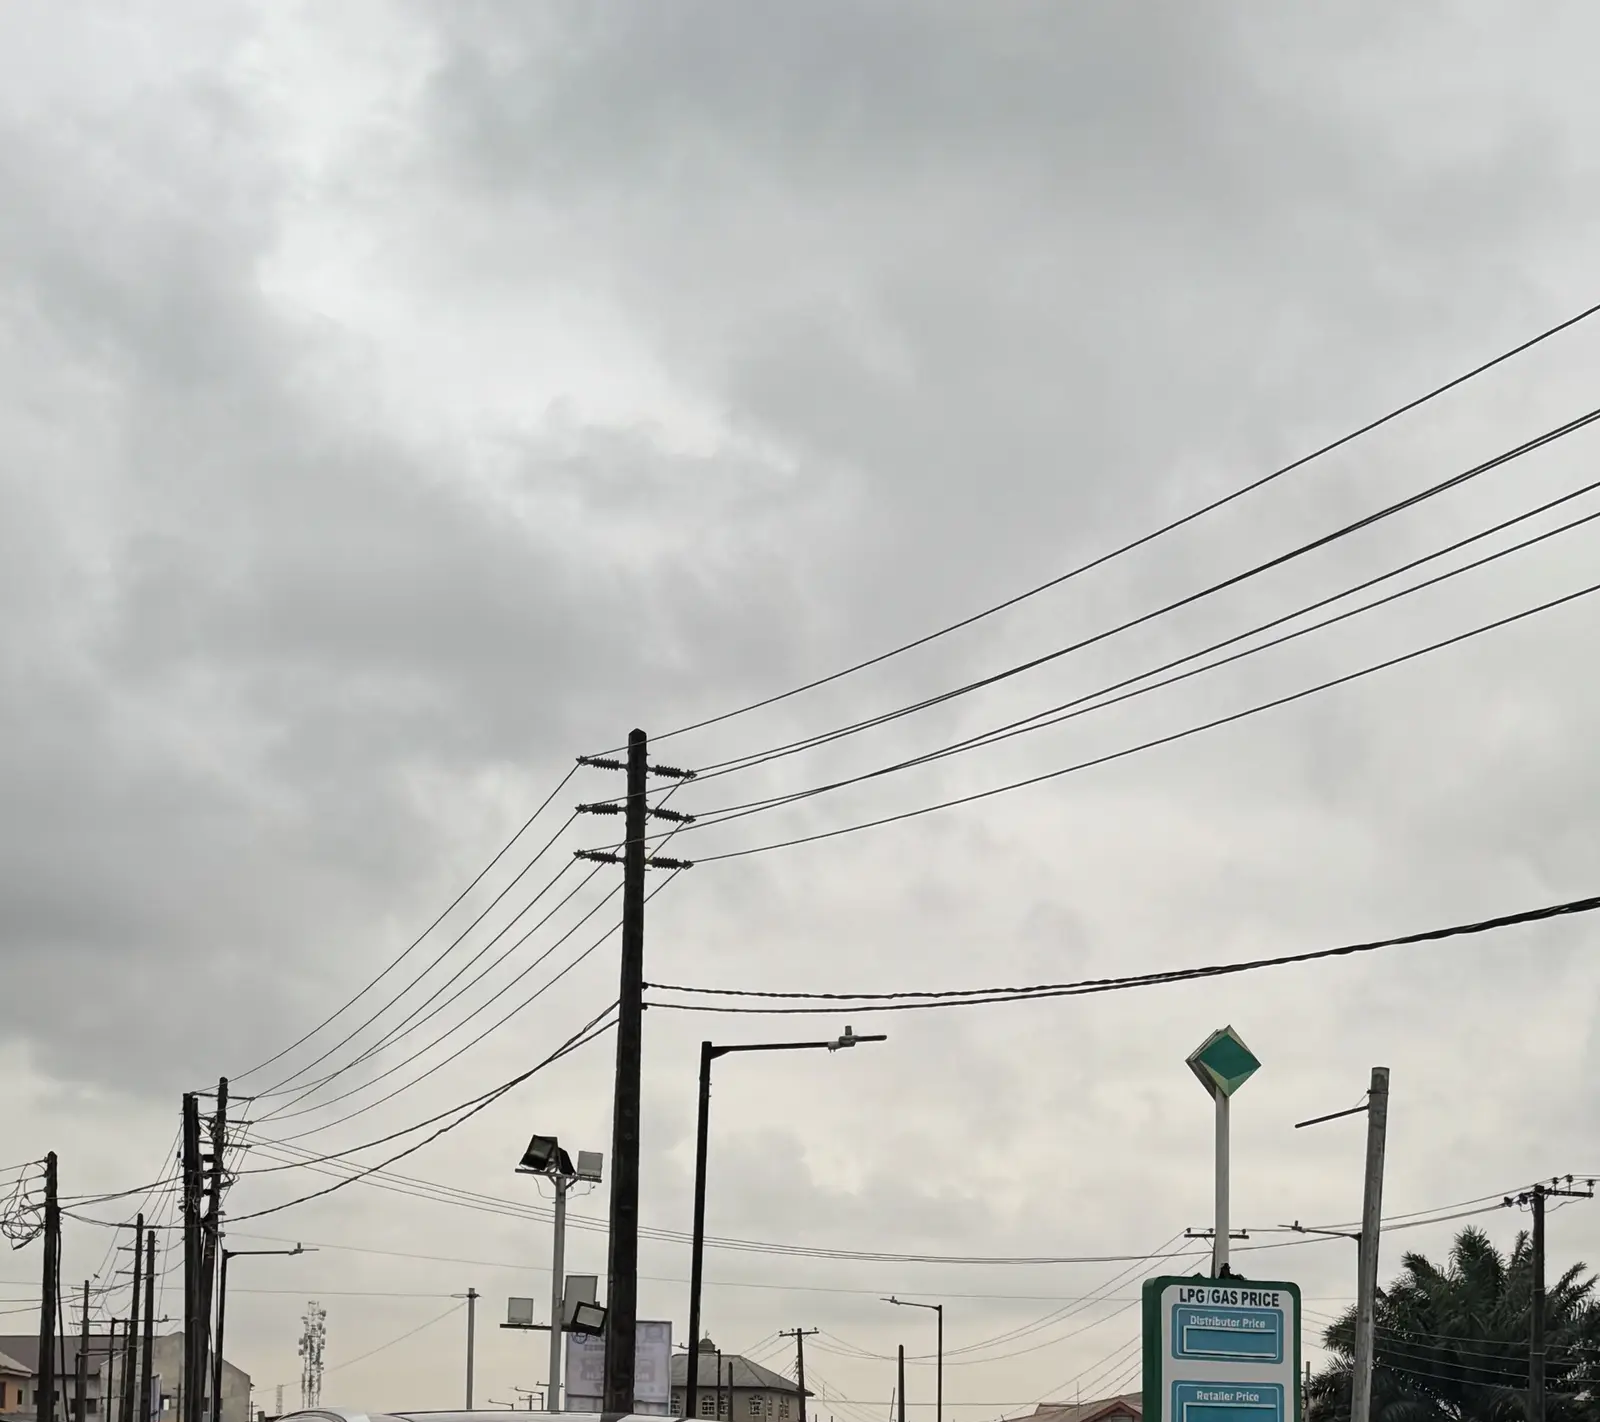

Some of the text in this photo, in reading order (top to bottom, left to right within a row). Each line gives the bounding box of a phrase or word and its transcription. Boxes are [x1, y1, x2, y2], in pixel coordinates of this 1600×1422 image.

[1241, 1291, 1280, 1307] PRICE
[1190, 1315, 1266, 1328] Distributor Price
[1196, 1390, 1260, 1402] Retailer Price
